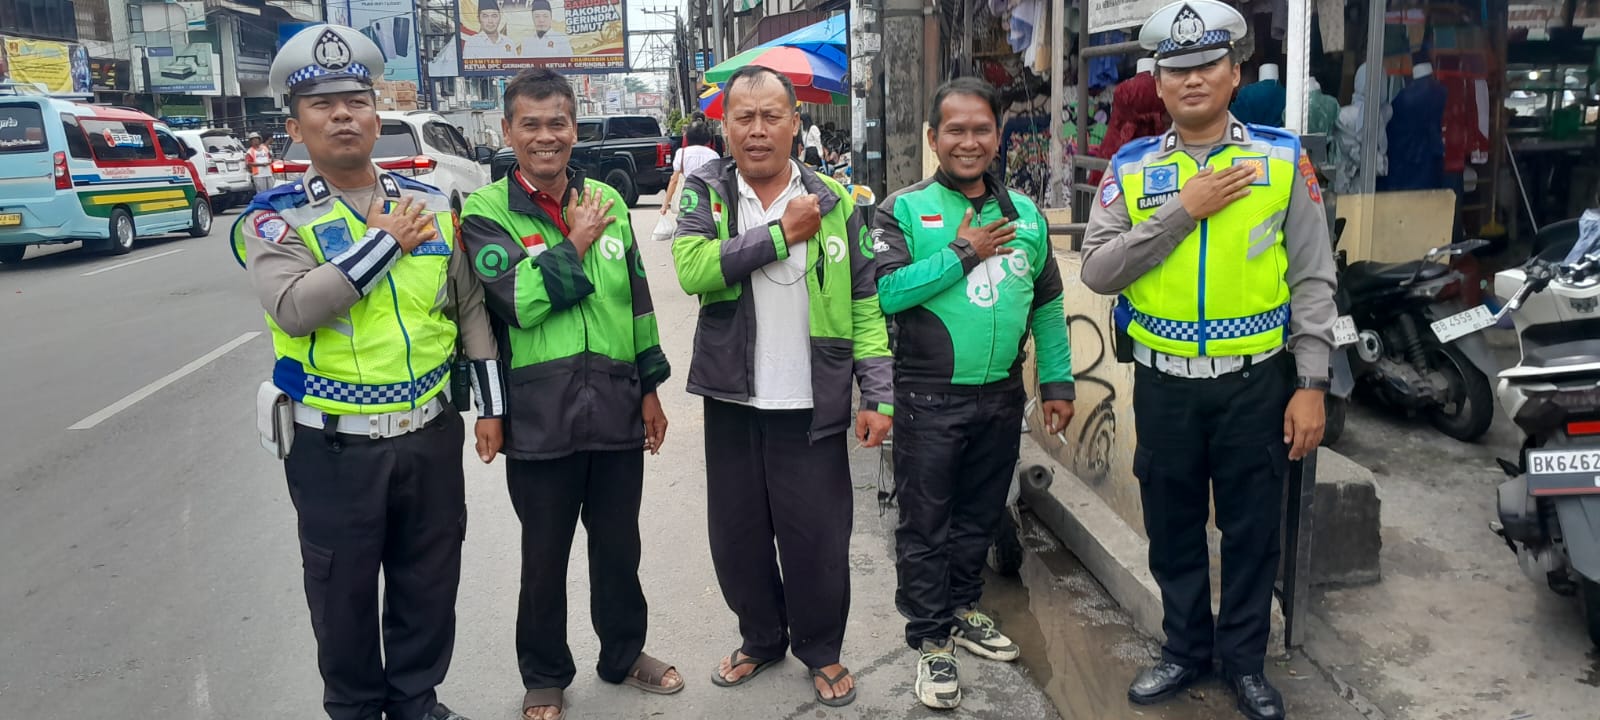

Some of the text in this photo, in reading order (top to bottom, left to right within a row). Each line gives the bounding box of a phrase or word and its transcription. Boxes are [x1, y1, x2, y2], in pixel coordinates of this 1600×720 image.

[565, 4, 616, 17] RAKORDA
[565, 11, 619, 26] GERINDRA
[566, 22, 603, 34] SUMUT
[1433, 321, 1448, 333] BB
[1449, 312, 1473, 327] 4559
